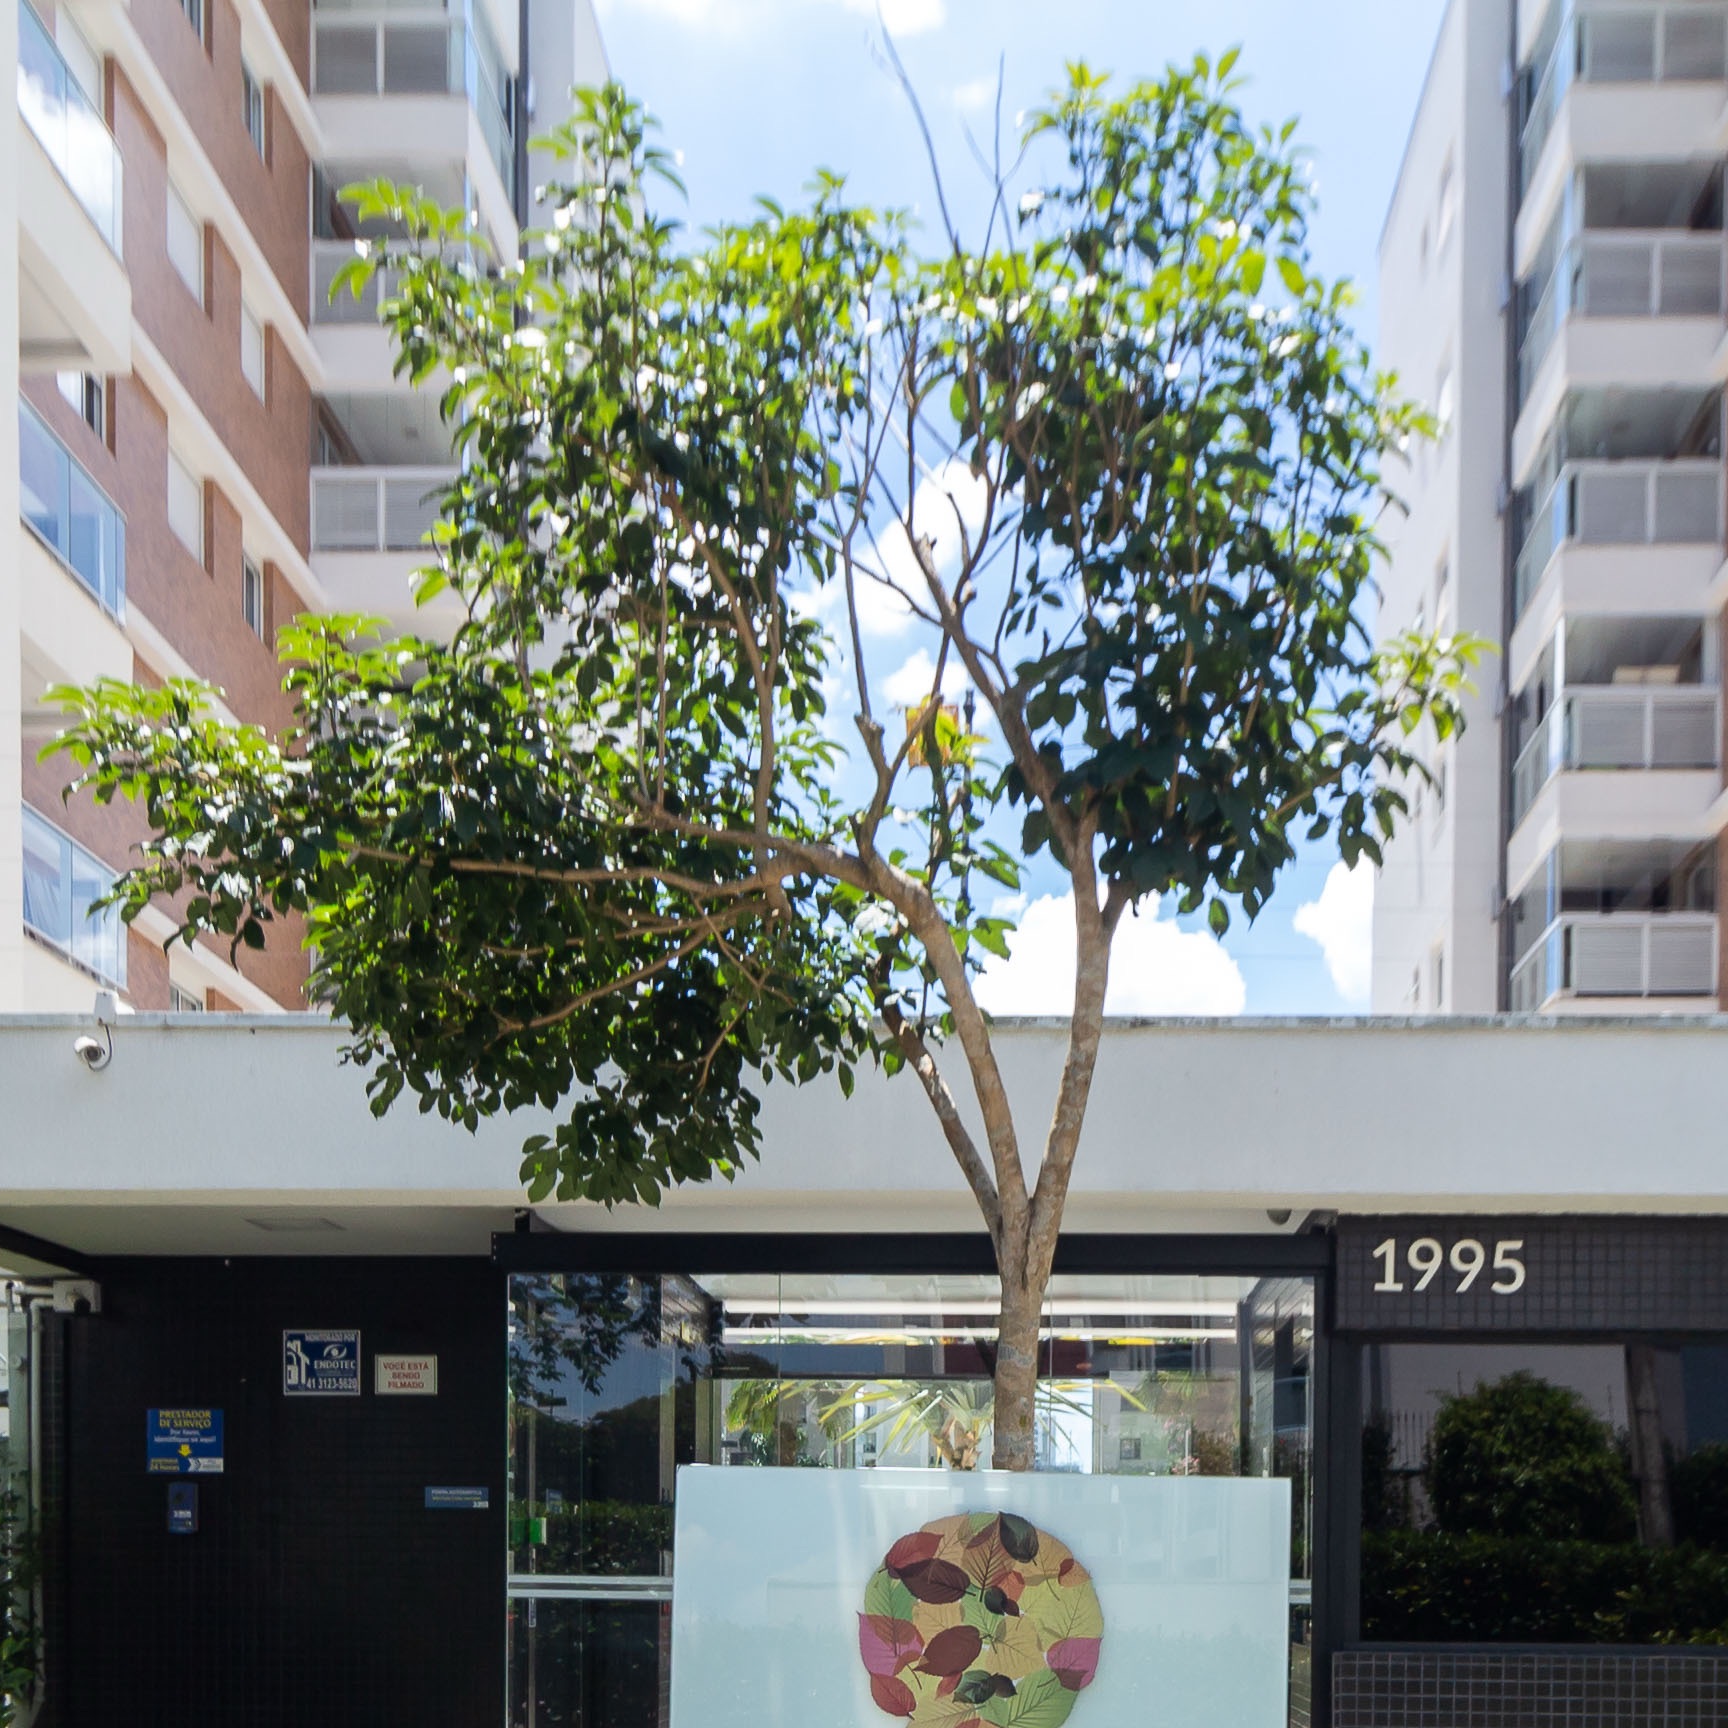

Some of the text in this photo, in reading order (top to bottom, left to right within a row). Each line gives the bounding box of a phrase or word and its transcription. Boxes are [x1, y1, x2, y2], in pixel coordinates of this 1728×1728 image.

[1370, 1237, 1526, 1296] 1995
[314, 1360, 356, 1370] ENDOTEC
[383, 1360, 429, 1371] VOCÊ ESTÁ
[392, 1372, 420, 1380] SENDO
[306, 1378, 317, 1390] 41
[388, 1381, 424, 1390] FILMADO
[159, 1410, 211, 1419] PRESTADOR
[159, 1419, 211, 1429] DE SERVIÇO
